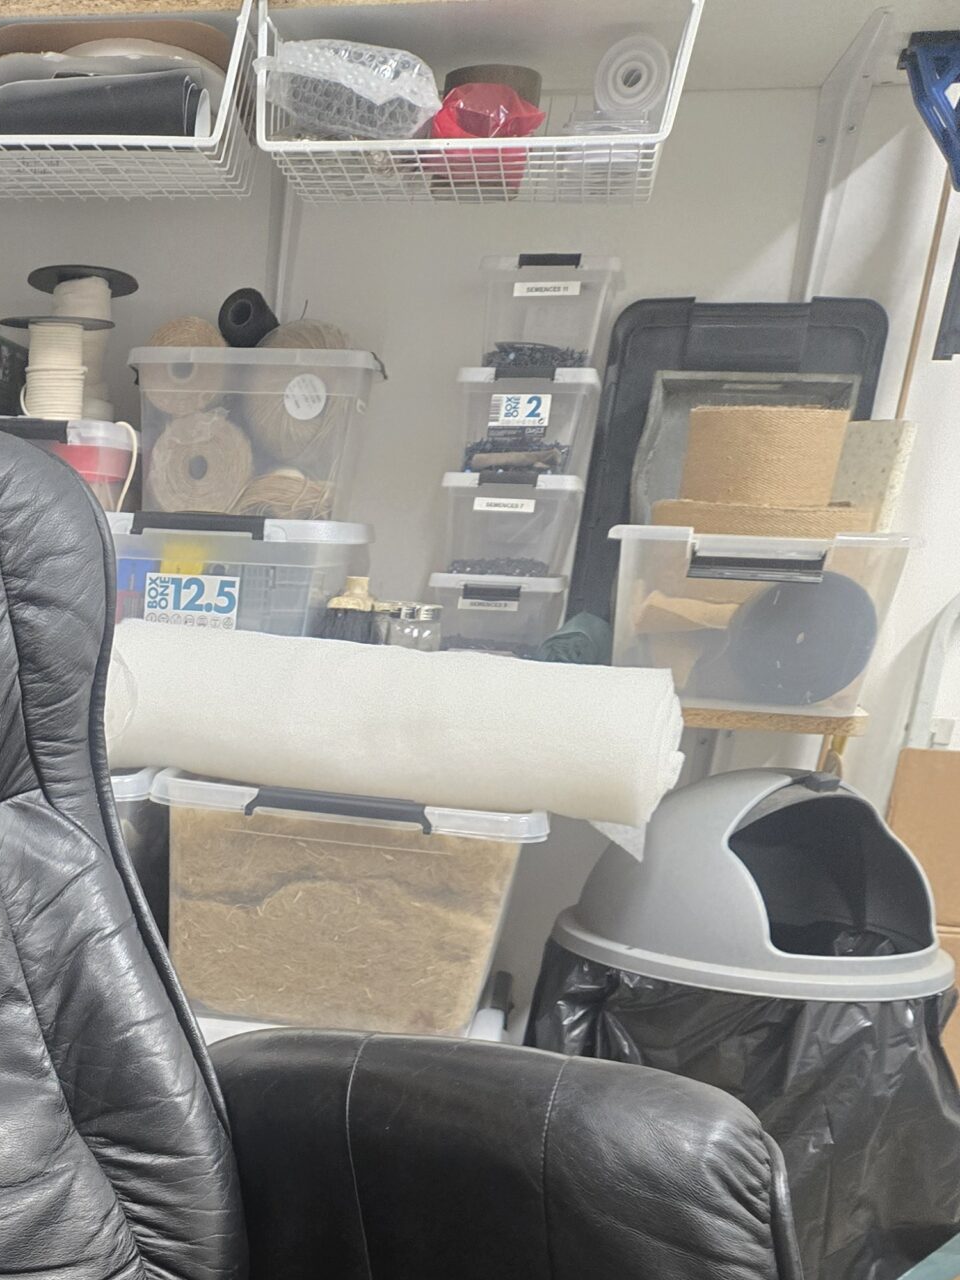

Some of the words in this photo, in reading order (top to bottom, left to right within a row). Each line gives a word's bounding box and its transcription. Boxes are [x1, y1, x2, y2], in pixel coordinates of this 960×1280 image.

[504, 396, 514, 418] BOX
[511, 396, 521, 418] ONE
[525, 395, 543, 418] 2
[147, 576, 159, 609] BOX
[158, 576, 171, 610] ONE
[171, 577, 237, 614] 12.5
